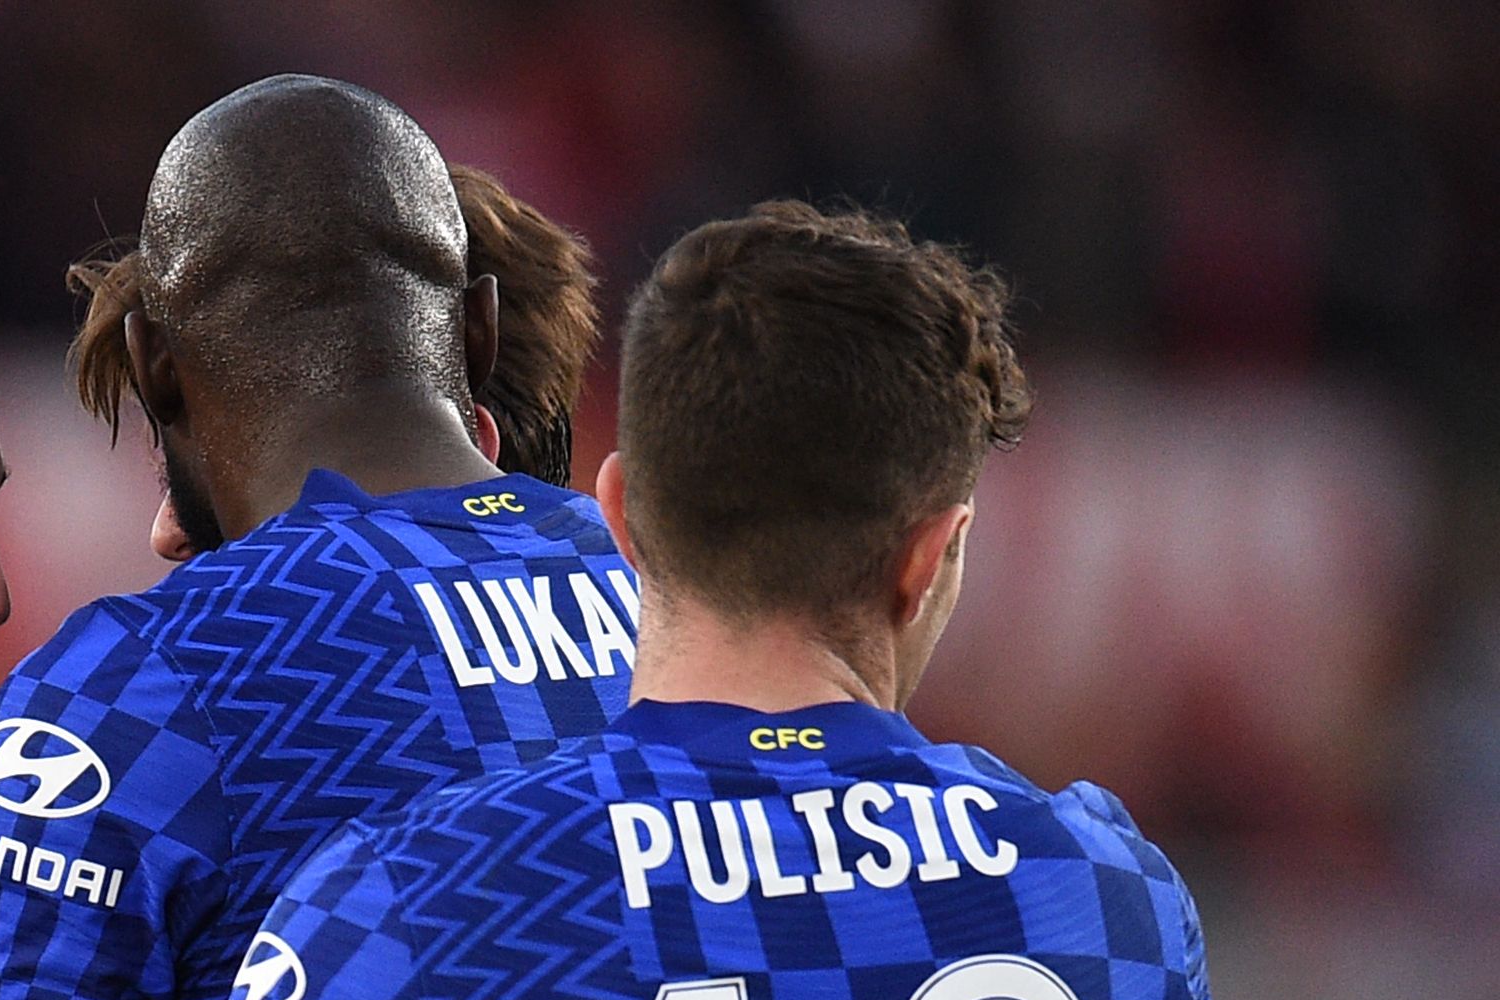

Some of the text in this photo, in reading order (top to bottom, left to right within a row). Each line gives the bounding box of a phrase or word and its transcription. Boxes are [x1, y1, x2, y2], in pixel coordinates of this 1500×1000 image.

[462, 493, 526, 516] CFC
[749, 727, 826, 750] CFC
[607, 780, 1019, 908] PULISIC
